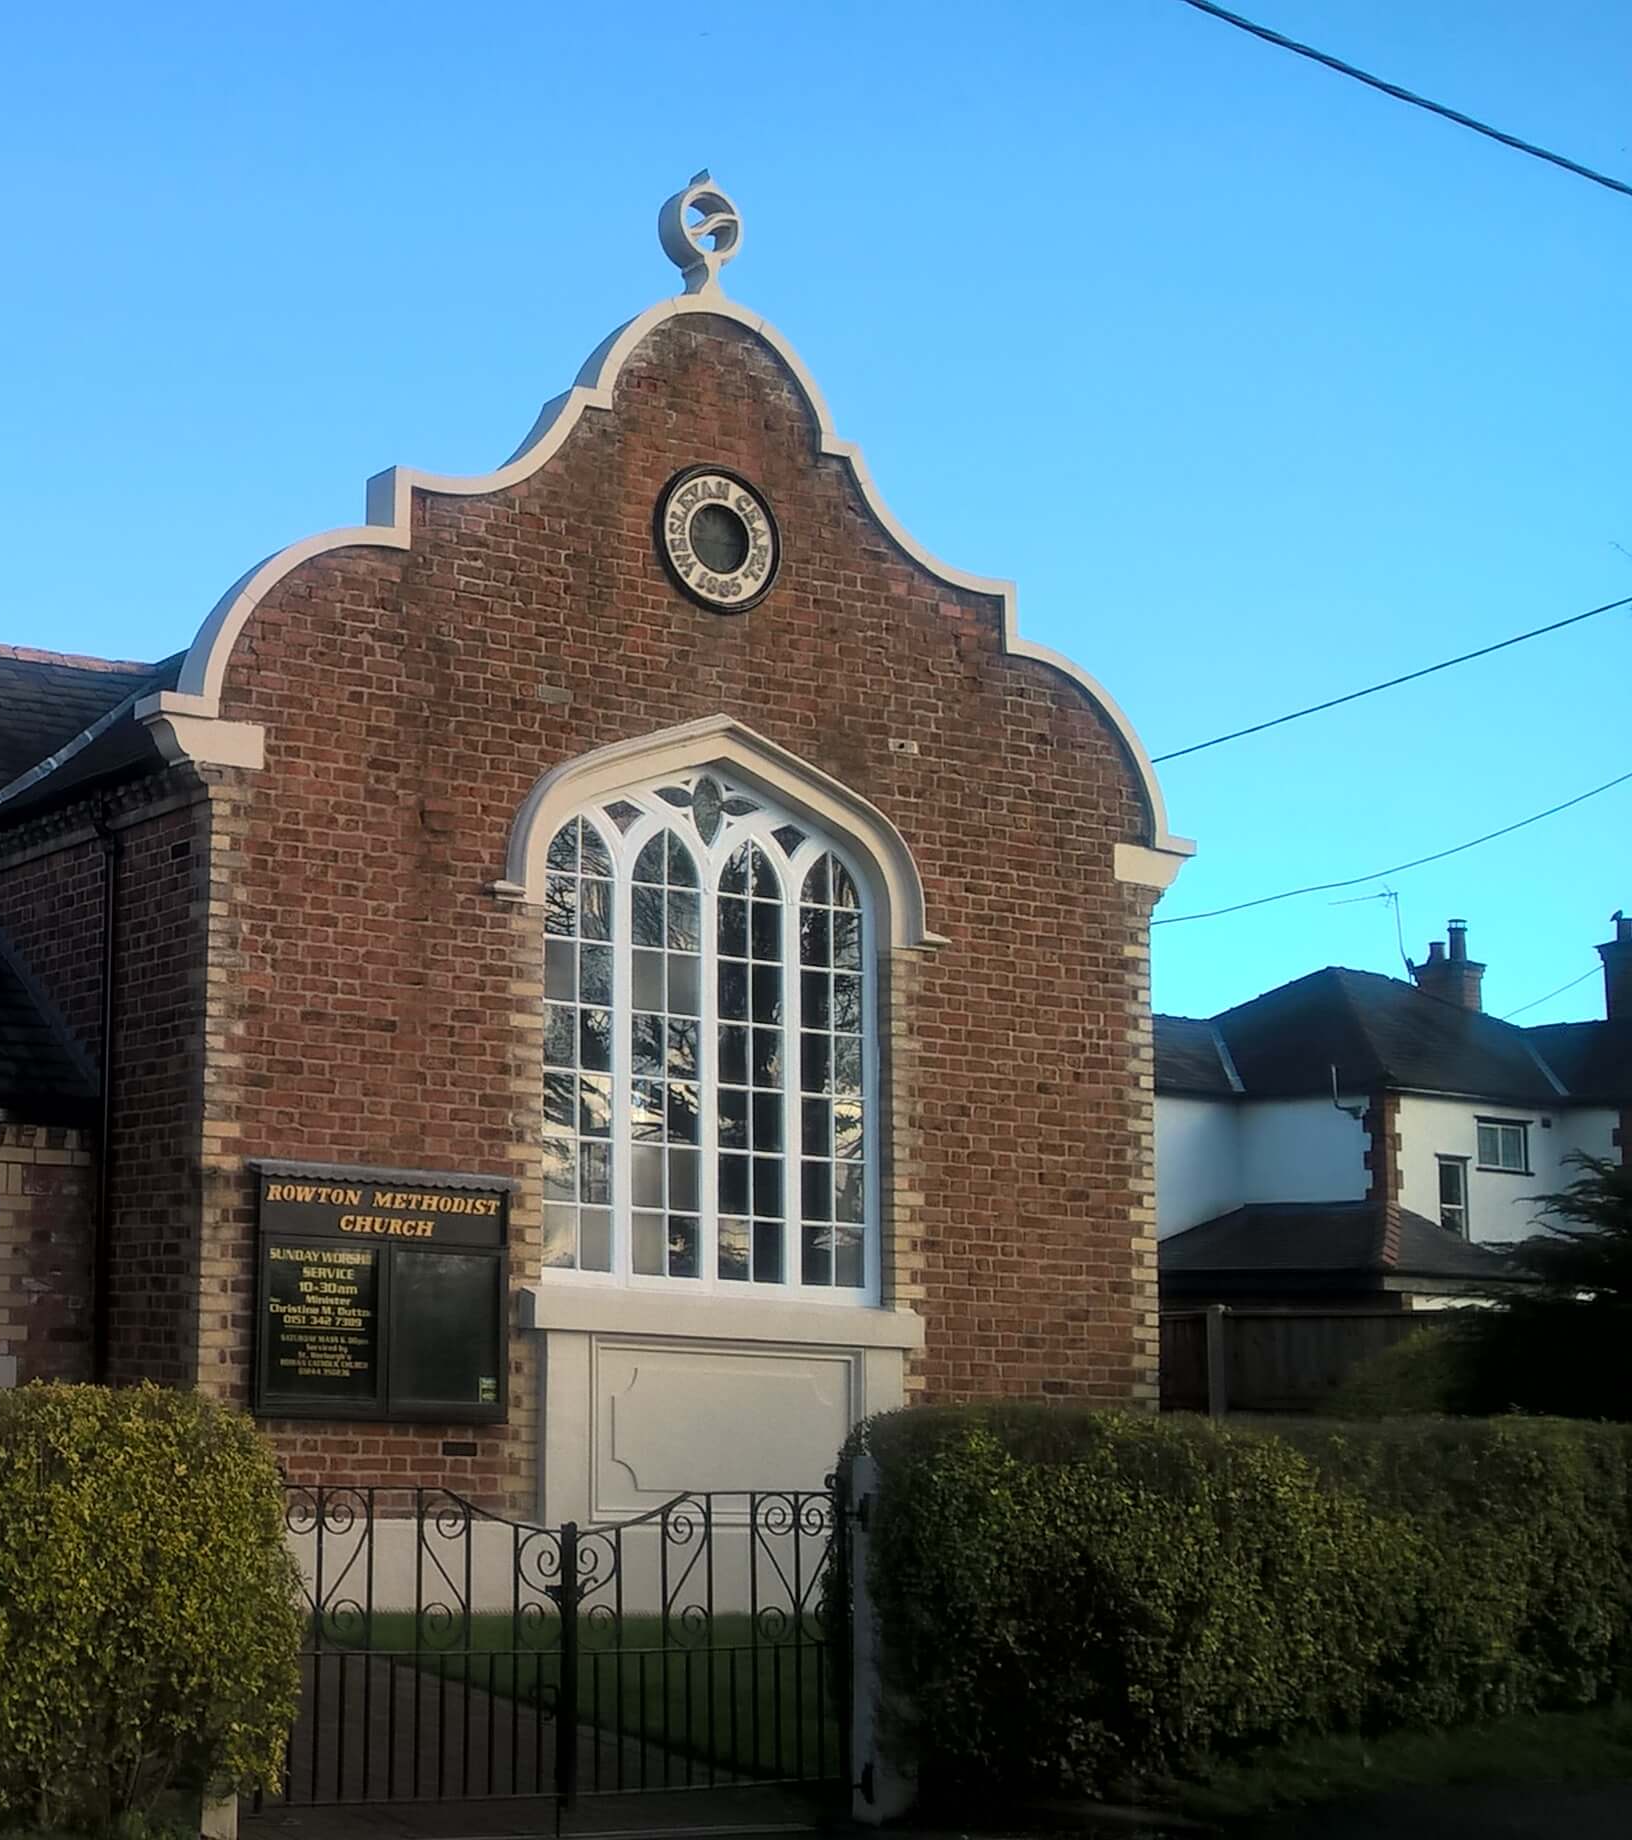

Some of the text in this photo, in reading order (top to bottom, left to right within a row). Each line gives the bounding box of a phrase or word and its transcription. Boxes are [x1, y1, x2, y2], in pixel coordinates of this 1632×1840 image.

[668, 480, 769, 582] WESLEYAN CHAPEL
[267, 1184, 501, 1216] ROWTON METHODIST
[339, 1214, 436, 1237] CHURCH
[270, 1247, 320, 1262] SUNDAY
[303, 1267, 355, 1280] SERVICE
[305, 1294, 352, 1305] Minister
[269, 1303, 319, 1315] Christine
